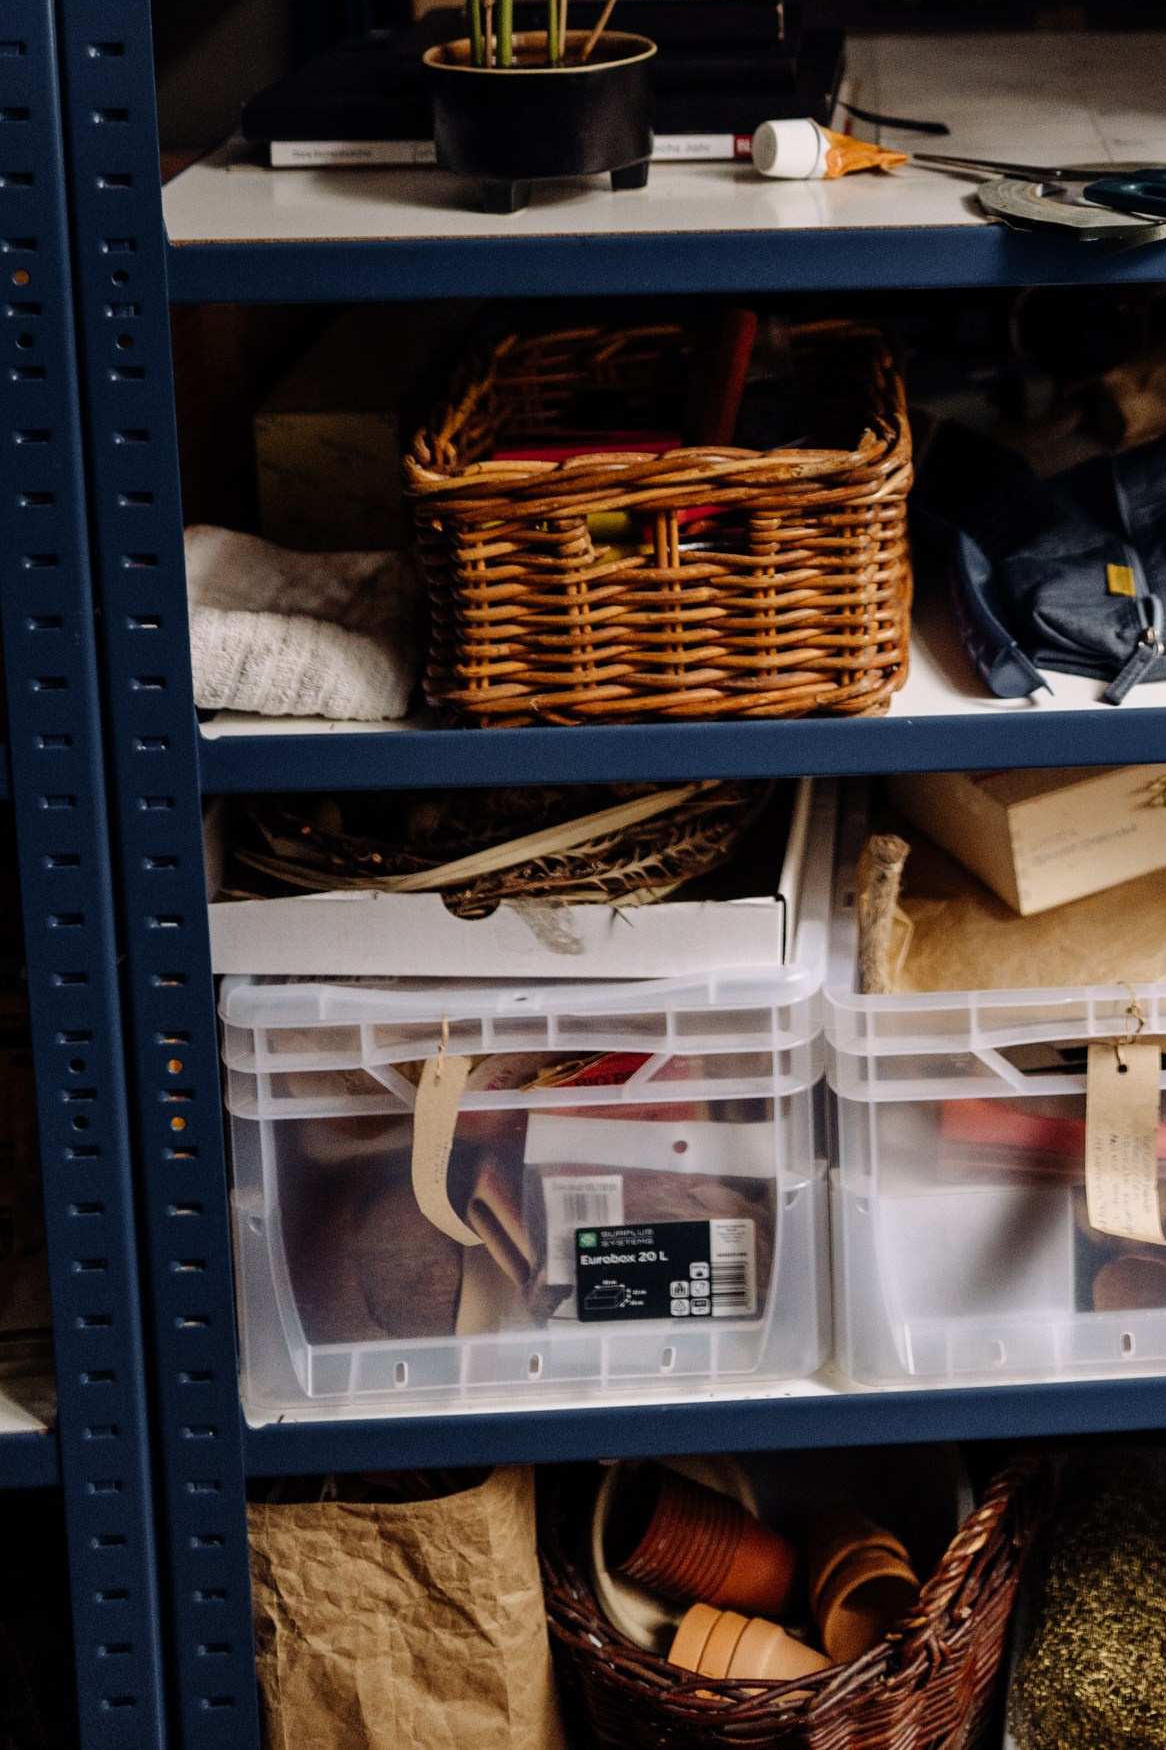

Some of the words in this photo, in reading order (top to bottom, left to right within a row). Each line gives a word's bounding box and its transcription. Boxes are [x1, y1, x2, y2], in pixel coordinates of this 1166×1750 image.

[600, 1228, 654, 1239] SURPLUS
[600, 1237, 654, 1248] SYSTEMS
[580, 1252, 637, 1266] Eurobox
[637, 1251, 657, 1263] 20
[659, 1250, 669, 1262] L
